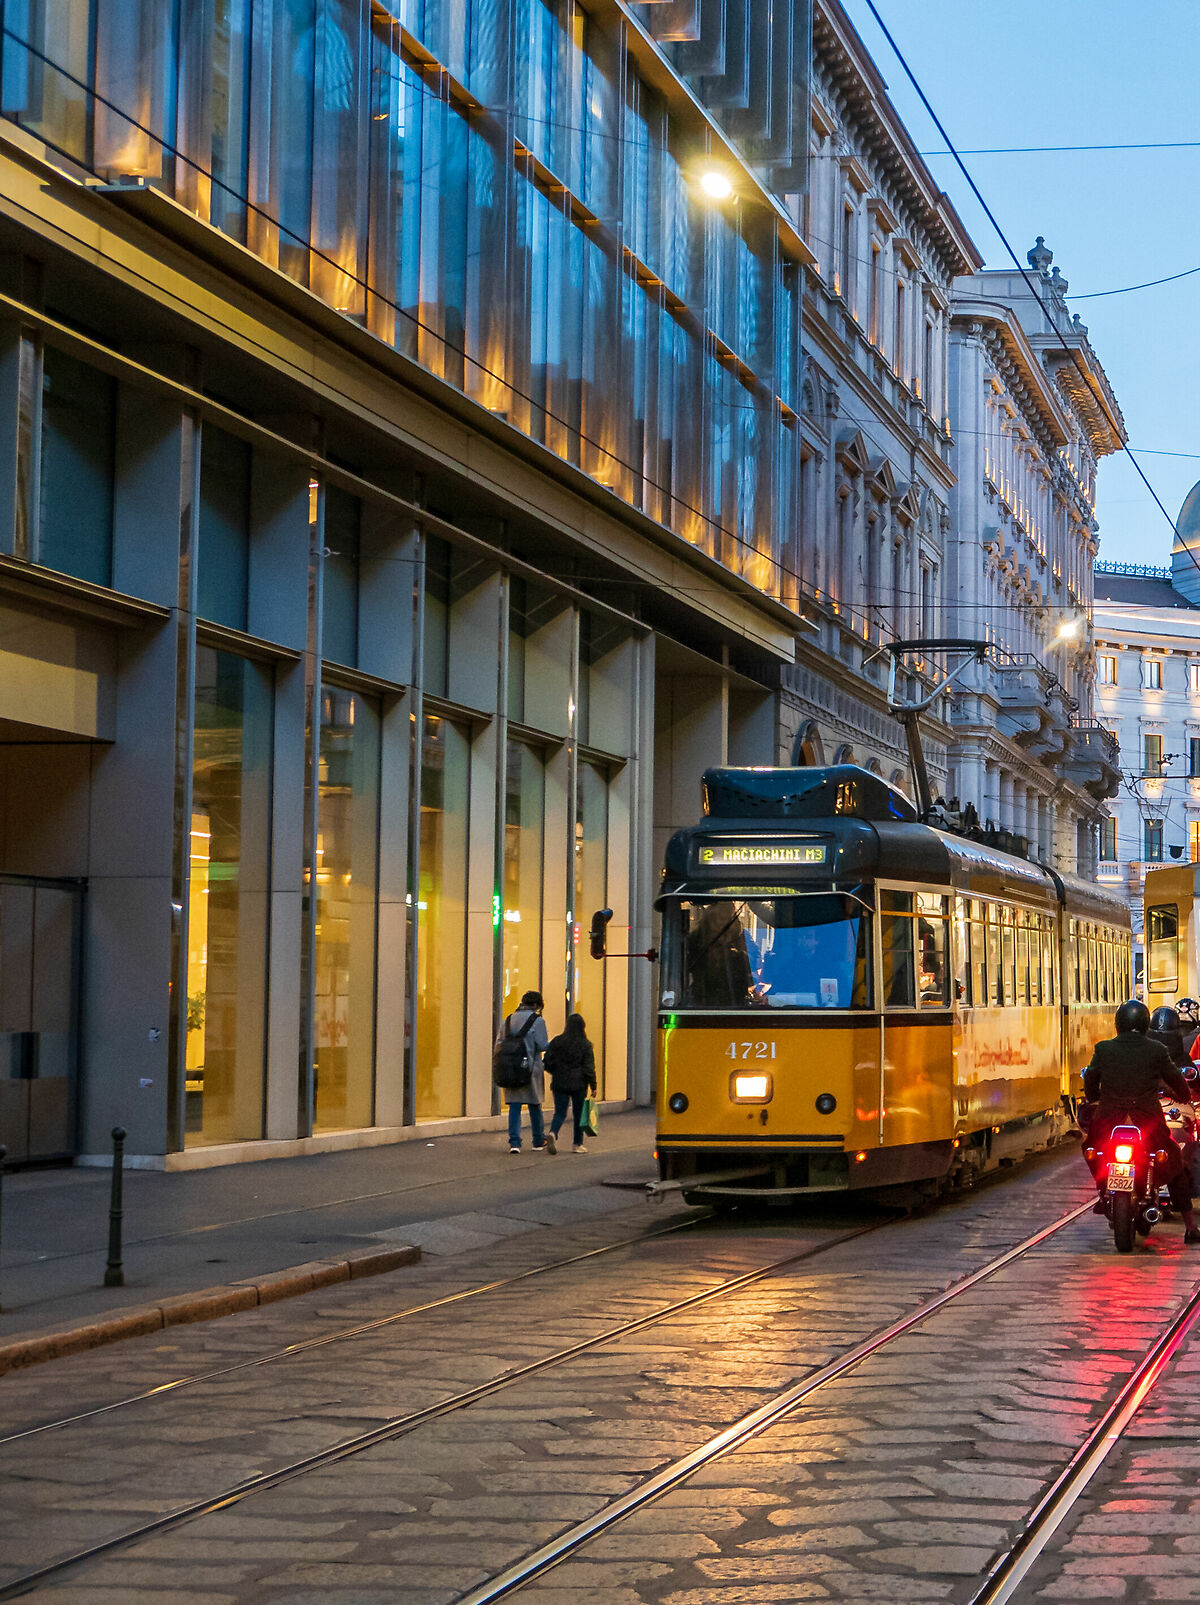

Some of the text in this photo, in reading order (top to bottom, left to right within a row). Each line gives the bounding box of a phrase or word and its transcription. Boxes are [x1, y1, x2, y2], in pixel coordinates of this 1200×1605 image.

[703, 849, 714, 861] 2
[805, 848, 823, 861] M3
[724, 1041, 777, 1060] 4721
[1108, 1177, 1134, 1190] 25824
